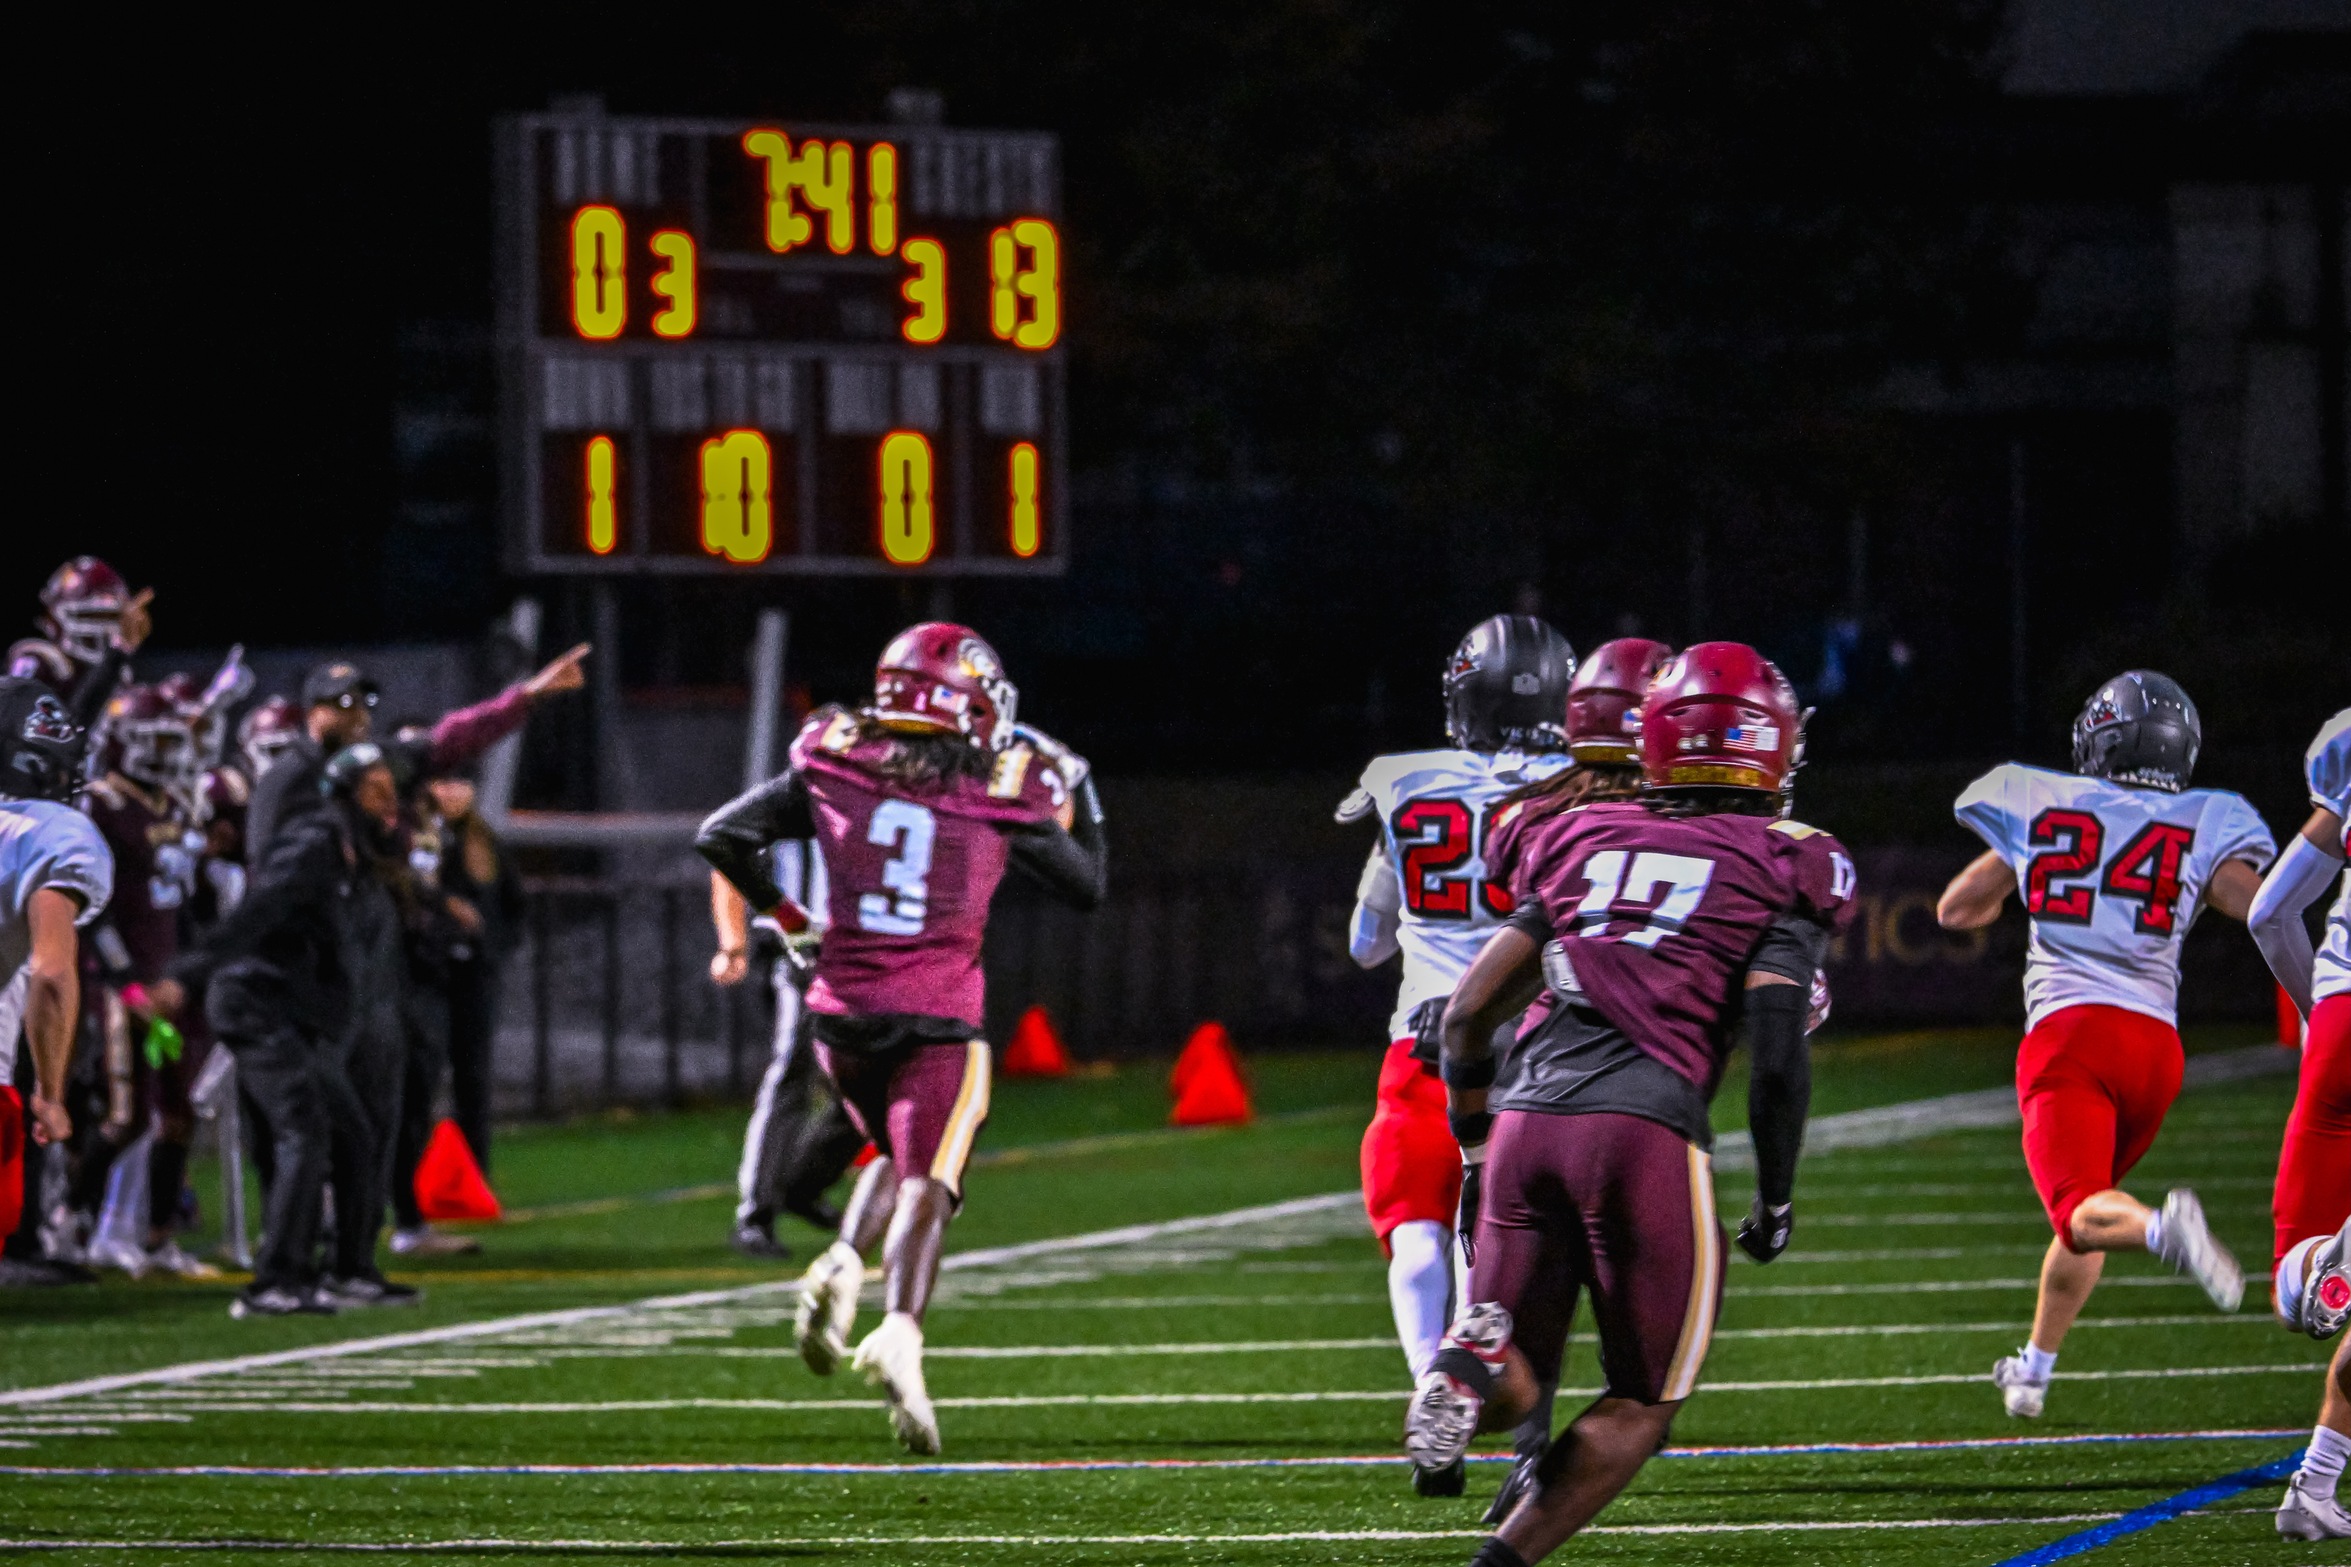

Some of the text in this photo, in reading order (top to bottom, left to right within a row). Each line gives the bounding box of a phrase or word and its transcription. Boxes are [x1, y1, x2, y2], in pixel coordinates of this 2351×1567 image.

[743, 130, 897, 256] 7:41
[571, 205, 626, 340] 0
[650, 230, 696, 337] 3
[901, 237, 946, 344] 3
[990, 218, 1059, 350] 13
[586, 435, 615, 554] 1
[700, 428, 771, 563] 10
[879, 431, 933, 564] 0
[1010, 442, 1039, 557] 1
[858, 799, 936, 936] 3
[1577, 850, 1716, 949] 17
[2026, 807, 2196, 939] 24
